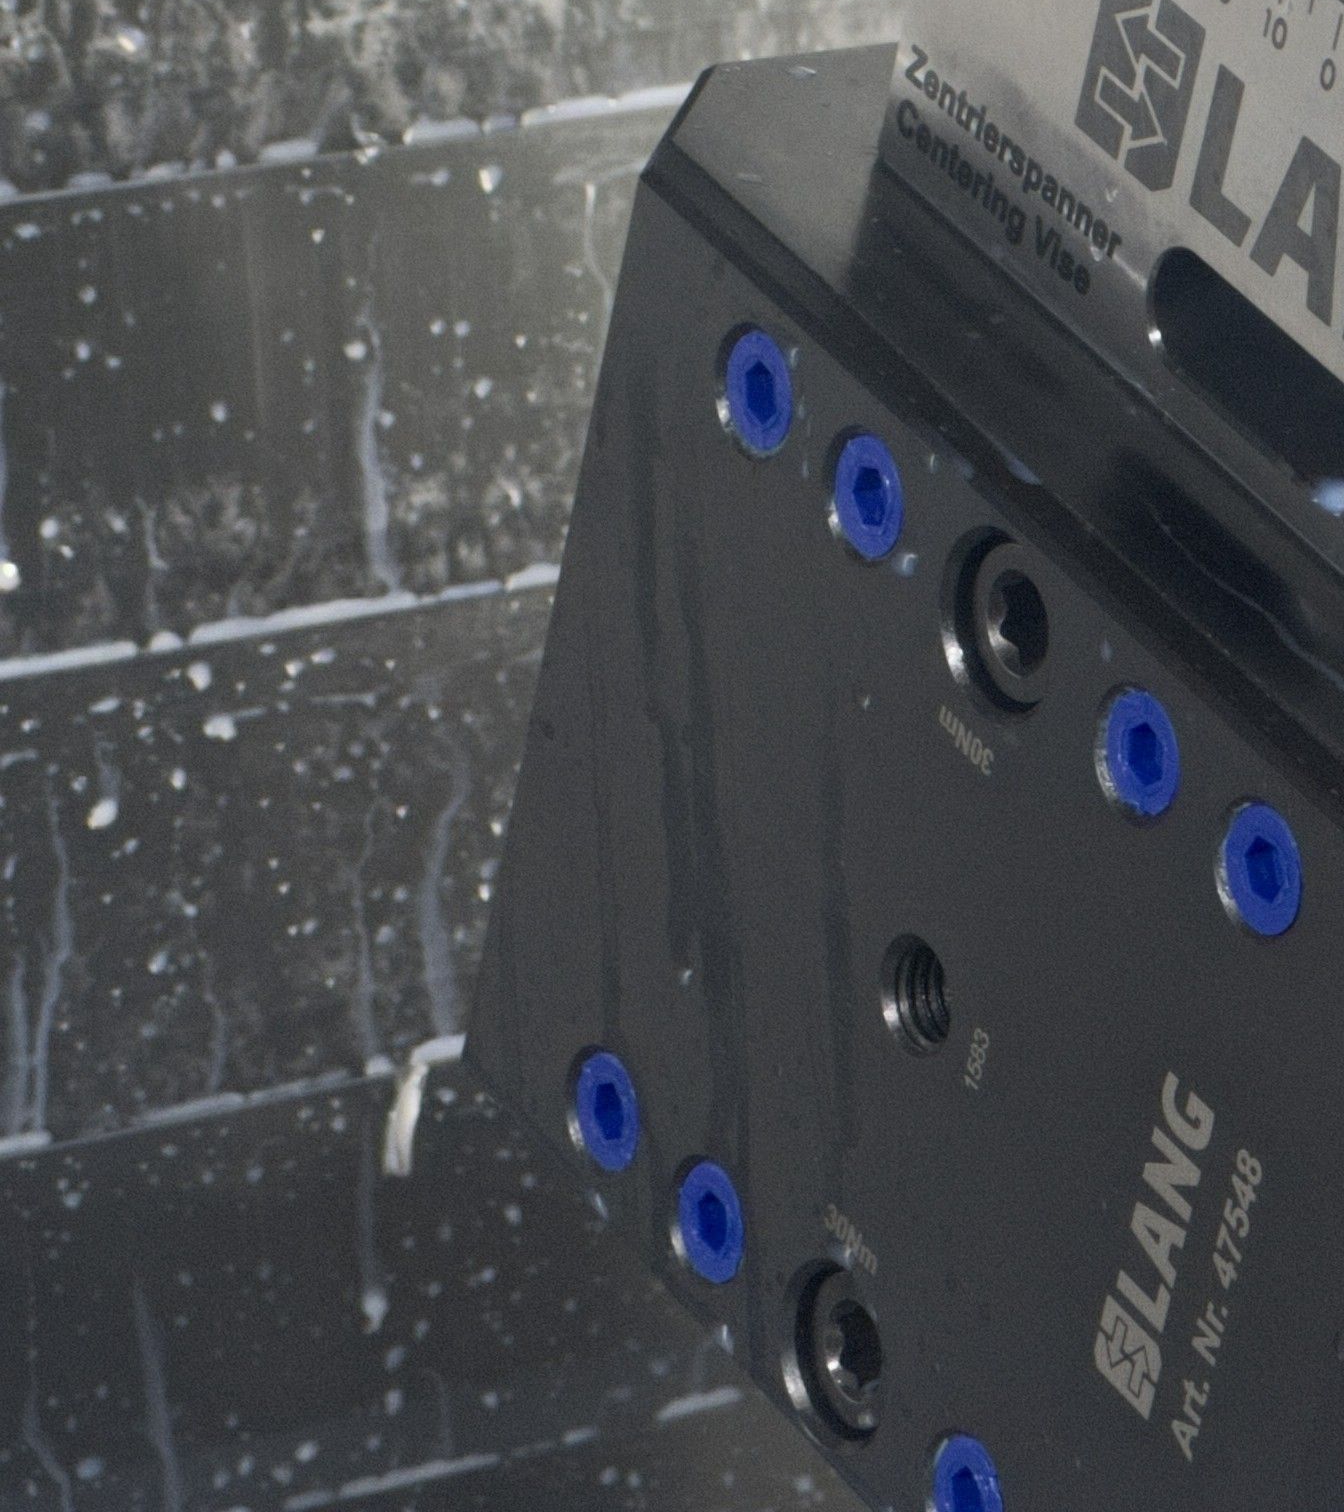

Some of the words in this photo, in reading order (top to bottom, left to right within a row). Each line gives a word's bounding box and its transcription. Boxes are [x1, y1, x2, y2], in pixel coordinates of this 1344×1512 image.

[1262, 7, 1288, 50] 10
[1319, 58, 1336, 91] 0
[896, 98, 1027, 246] Centering
[1033, 214, 1091, 296] Vise
[904, 43, 1123, 260] Zentrierspanner
[939, 705, 995, 776] 30Nm
[963, 1027, 990, 1090] 1583
[1116, 1071, 1216, 1334] LANG
[1170, 1378, 1210, 1463] Art.
[1190, 1299, 1229, 1367] Nr.
[1211, 1148, 1264, 1289] 47548
